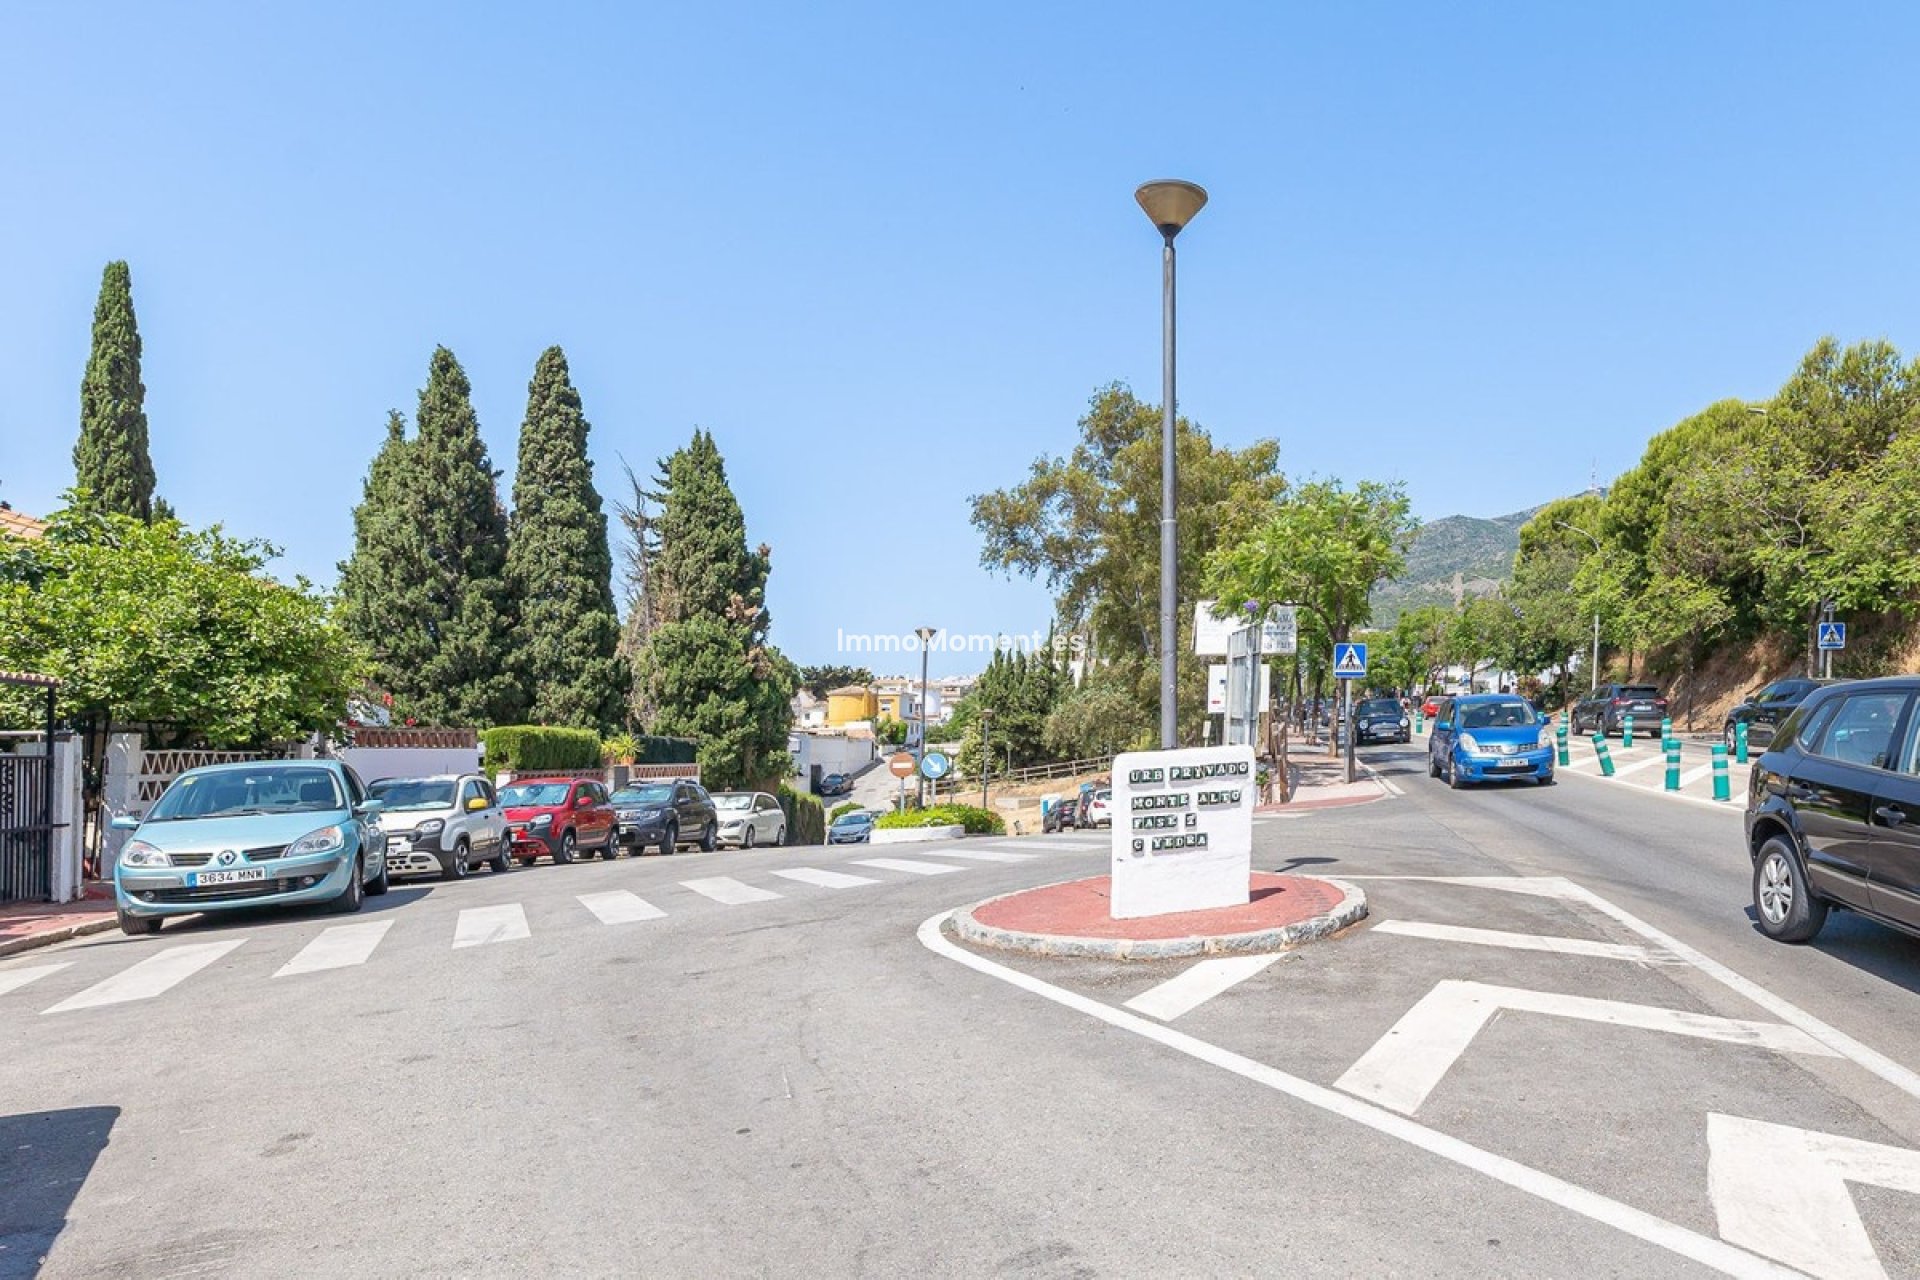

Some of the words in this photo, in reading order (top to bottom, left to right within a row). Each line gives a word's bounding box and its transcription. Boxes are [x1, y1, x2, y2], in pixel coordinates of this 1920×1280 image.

[1130, 769, 1163, 783] URB
[1132, 794, 1189, 809] MONTE
[1198, 791, 1241, 804] ALTO
[1133, 815, 1177, 828] FASE
[1152, 834, 1206, 849] YEDRA
[199, 872, 233, 884] 3634
